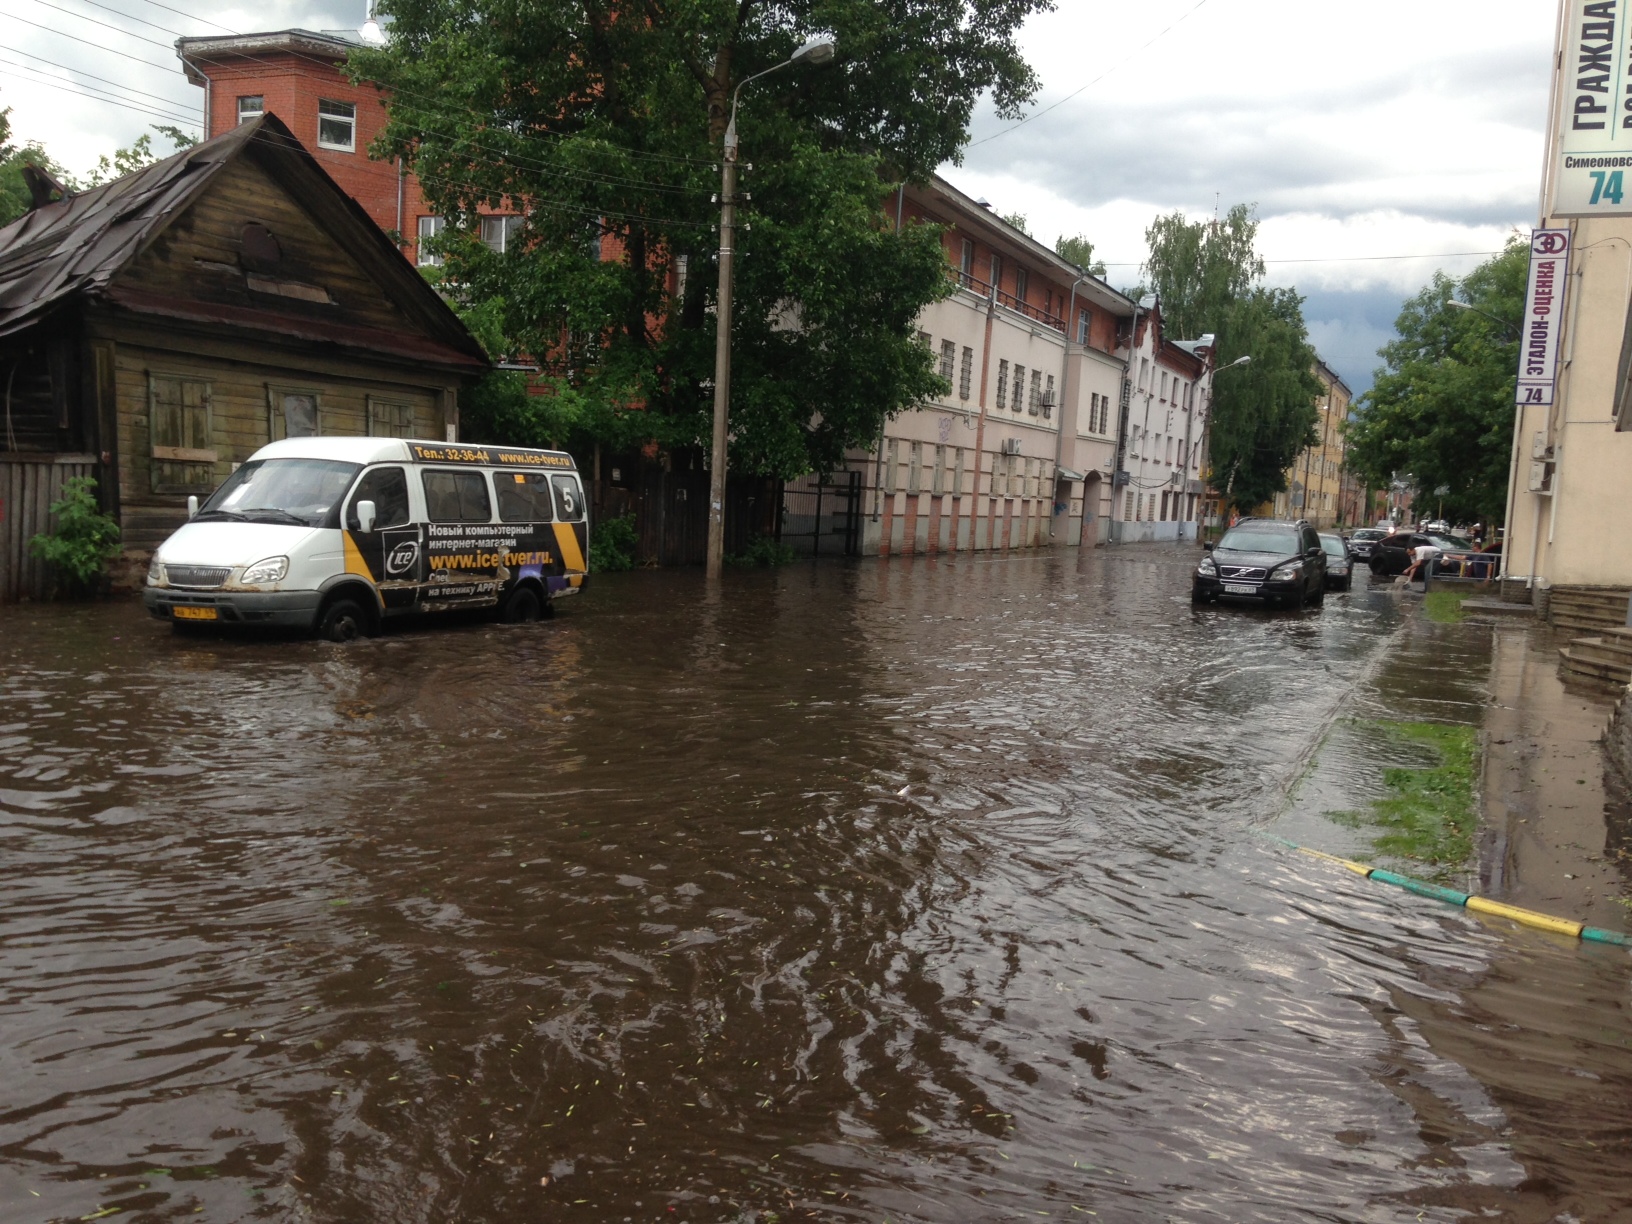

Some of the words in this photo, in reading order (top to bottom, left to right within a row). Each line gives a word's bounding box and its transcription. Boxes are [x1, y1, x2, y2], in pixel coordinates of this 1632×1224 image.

[1589, 171, 1624, 204] 74
[1526, 260, 1556, 375] ЭТАЛОН-ОЦЕНКА
[1525, 388, 1543, 402] 74
[415, 446, 443, 460] Тел.:
[447, 448, 490, 462] 32-36-44
[498, 452, 570, 466] www.ice-tver.ru
[562, 487, 574, 512] 5
[428, 525, 463, 536] Новый
[428, 538, 517, 551] интернет-магазин
[429, 550, 553, 570] www.icetver.ru.
[428, 588, 440, 597] на
[442, 586, 476, 599] технику
